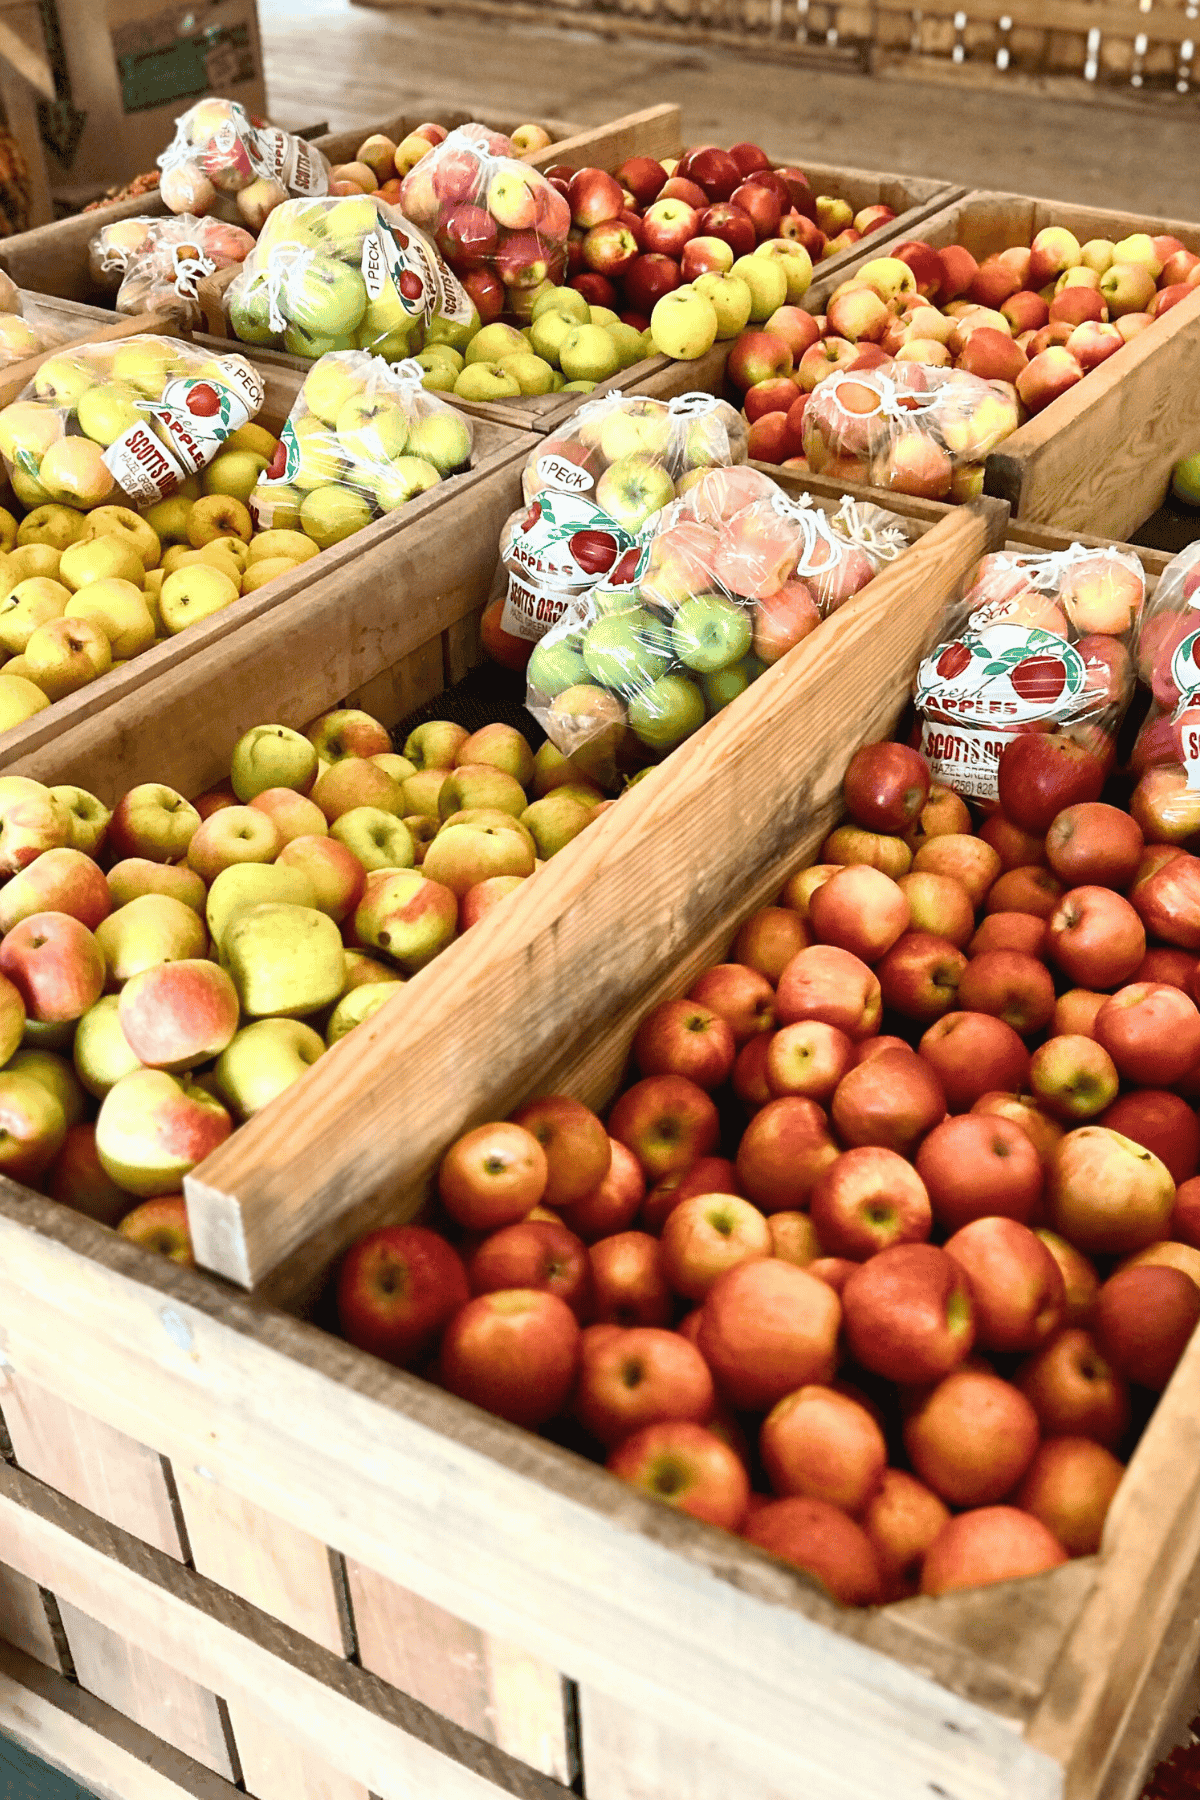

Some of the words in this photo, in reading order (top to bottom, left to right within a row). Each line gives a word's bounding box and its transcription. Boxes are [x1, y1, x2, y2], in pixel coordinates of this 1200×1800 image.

[367, 240, 380, 280] PECK
[441, 275, 457, 315] SCOTTS
[234, 368, 264, 408] PECK
[125, 430, 169, 478] SCOTTS
[541, 460, 547, 472] 1
[547, 462, 588, 488] PECK
[513, 546, 574, 577] APPLES
[915, 676, 997, 704] fresh
[925, 695, 1018, 714] APPLES
[925, 732, 981, 764] SCOTTS
[930, 762, 961, 777] HAZEL
[951, 779, 975, 795] (256)
